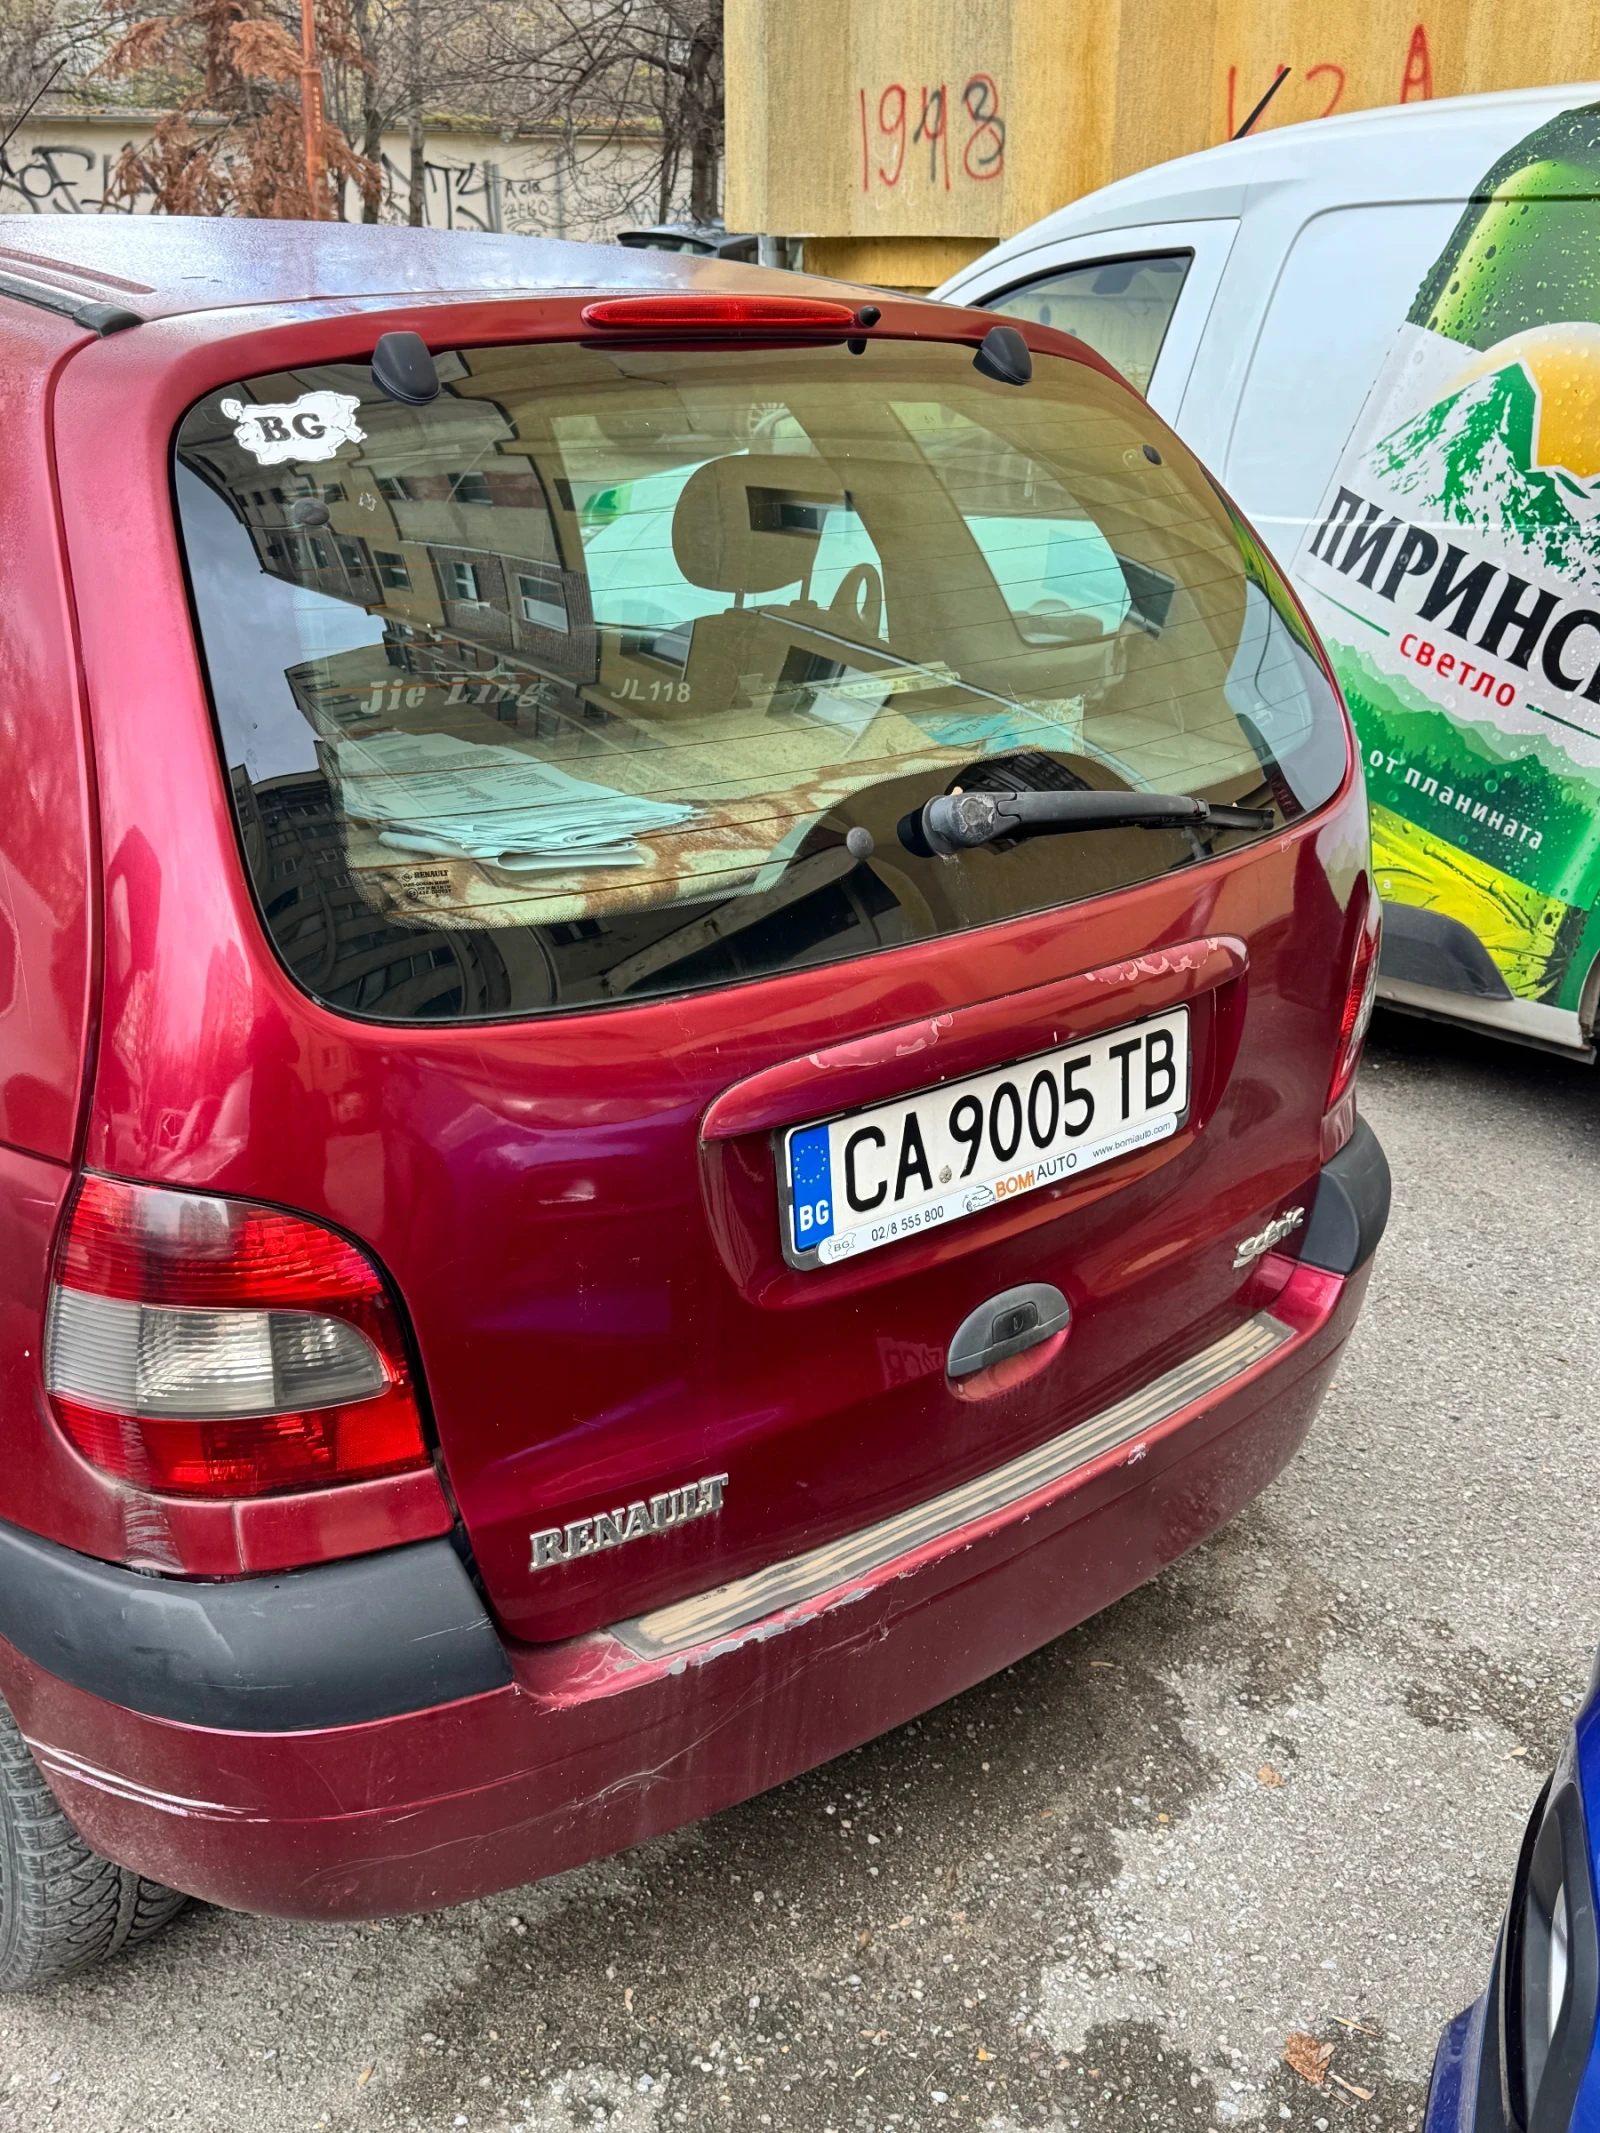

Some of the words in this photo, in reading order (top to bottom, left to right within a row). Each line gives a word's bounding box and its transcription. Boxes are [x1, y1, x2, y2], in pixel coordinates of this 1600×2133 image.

[254, 413, 327, 443] BG
[1308, 486, 1600, 703] ПИРИНС
[1400, 633, 1516, 707] светло
[360, 679, 427, 714] Jie
[444, 676, 550, 708] Ling
[1369, 750, 1398, 774] от
[1404, 767, 1544, 850] планината
[844, 1111, 934, 1213] CA
[949, 1054, 1095, 1179] 9005
[1109, 1028, 1176, 1121] TB
[1092, 1122, 1171, 1158] www.bomiauto.com
[1036, 1152, 1077, 1181] AUTO
[799, 1200, 829, 1232] BG
[871, 1221, 898, 1242] 02/8
[901, 1213, 922, 1232] 555
[924, 1205, 945, 1223] 800
[833, 1240, 850, 1253] BG
[529, 1472, 728, 1572] RENAULT
